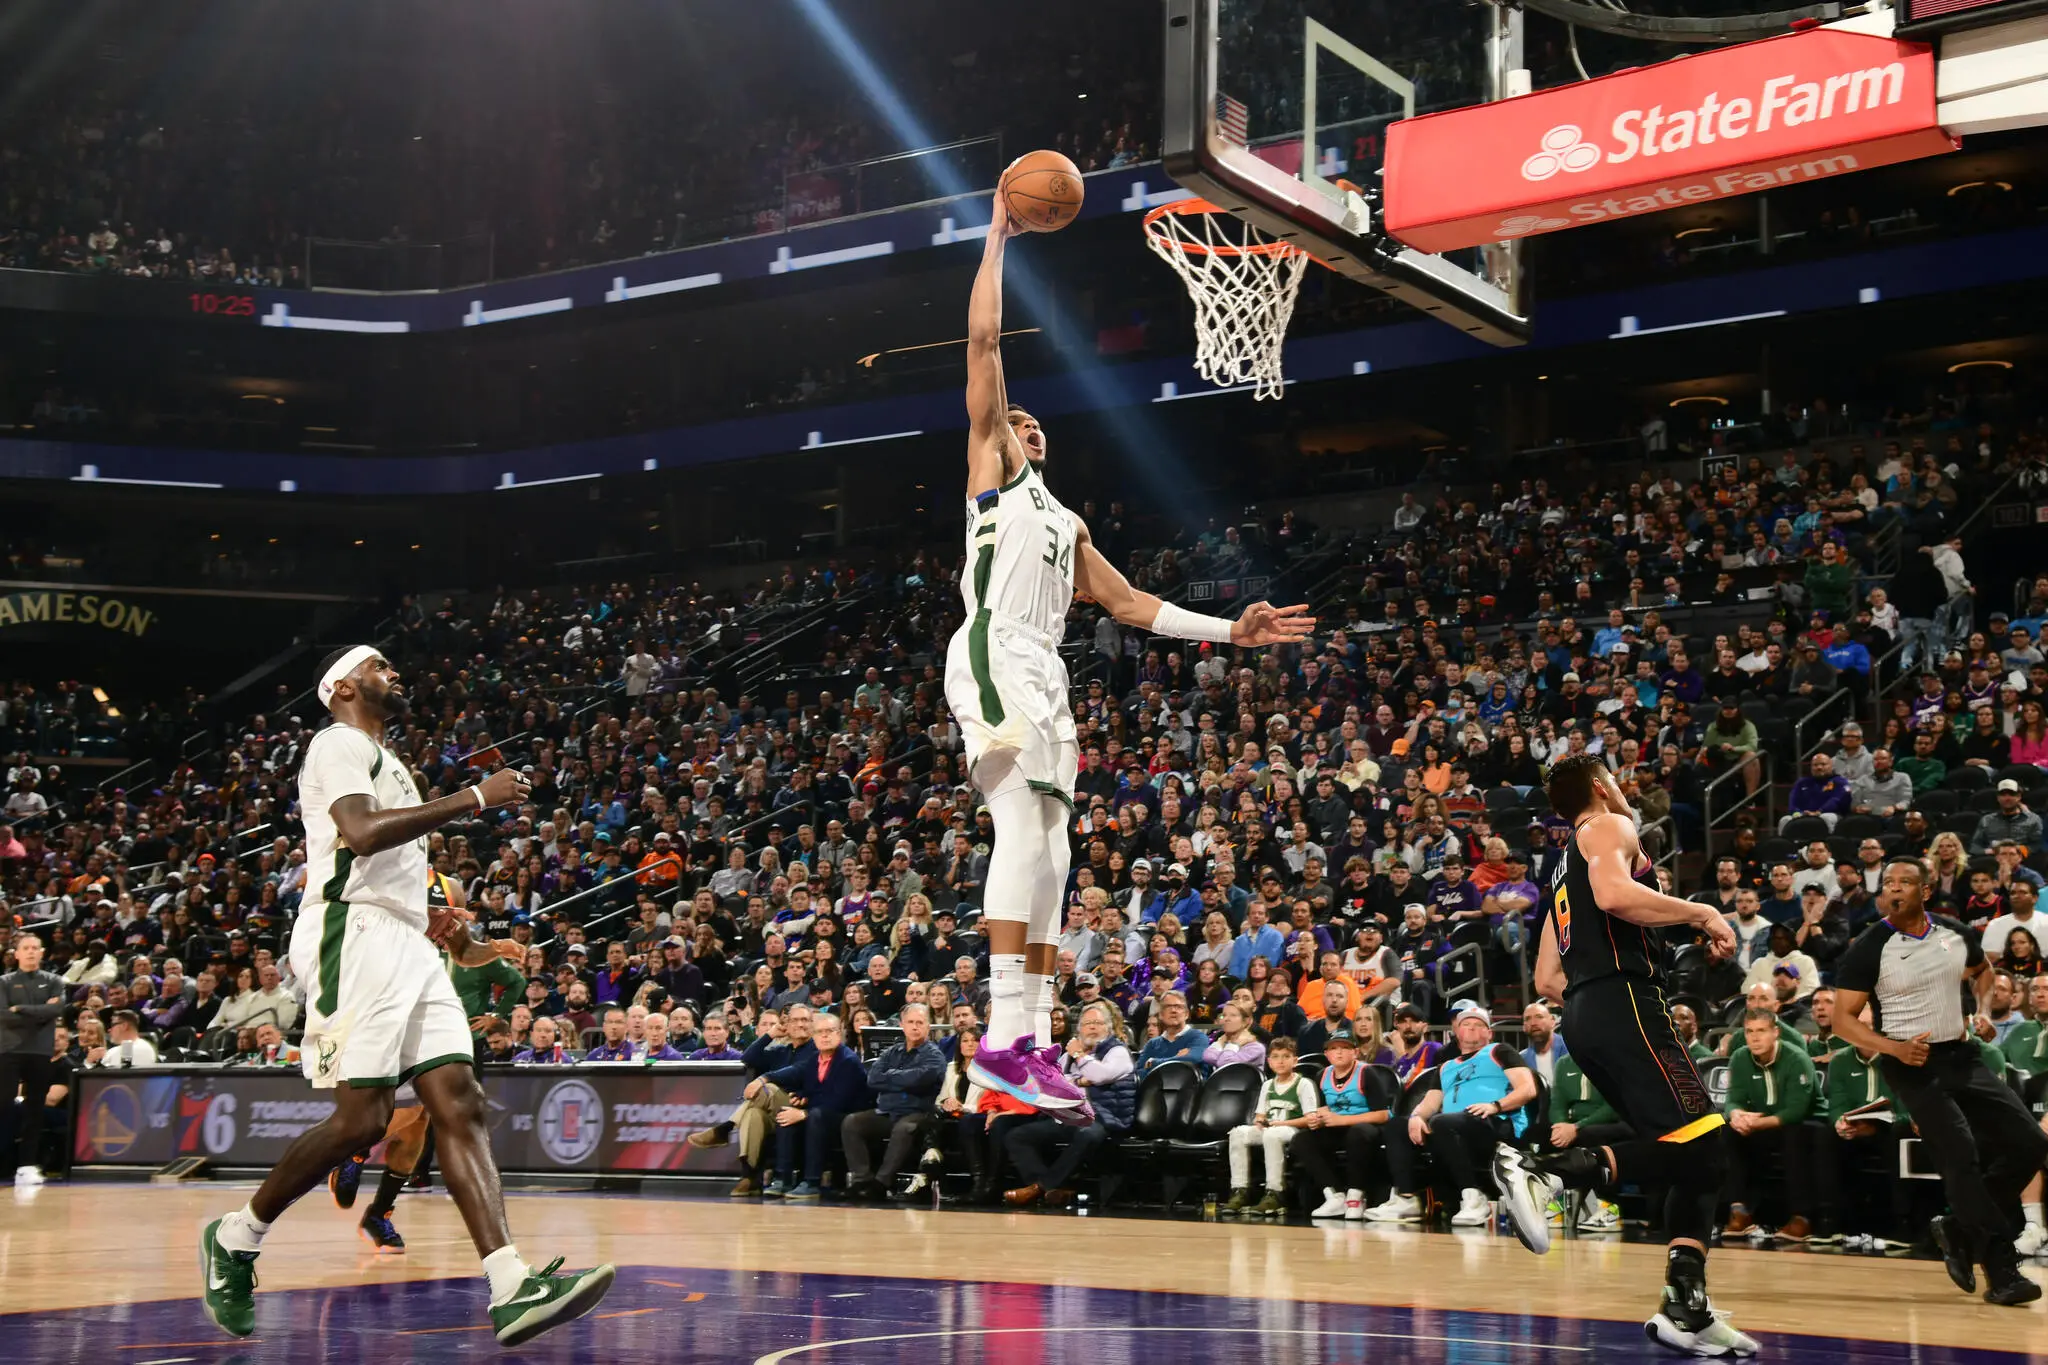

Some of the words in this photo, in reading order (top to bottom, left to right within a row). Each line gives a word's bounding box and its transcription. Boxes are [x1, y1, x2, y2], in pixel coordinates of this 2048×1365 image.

[1354, 135, 1376, 160] 21
[190, 293, 256, 316] 10:25
[1042, 524, 1071, 579] 34
[1193, 584, 1209, 598] 101
[1554, 883, 1571, 956] 8
[179, 1092, 237, 1154] 76
[248, 1100, 338, 1121] TOMORR
